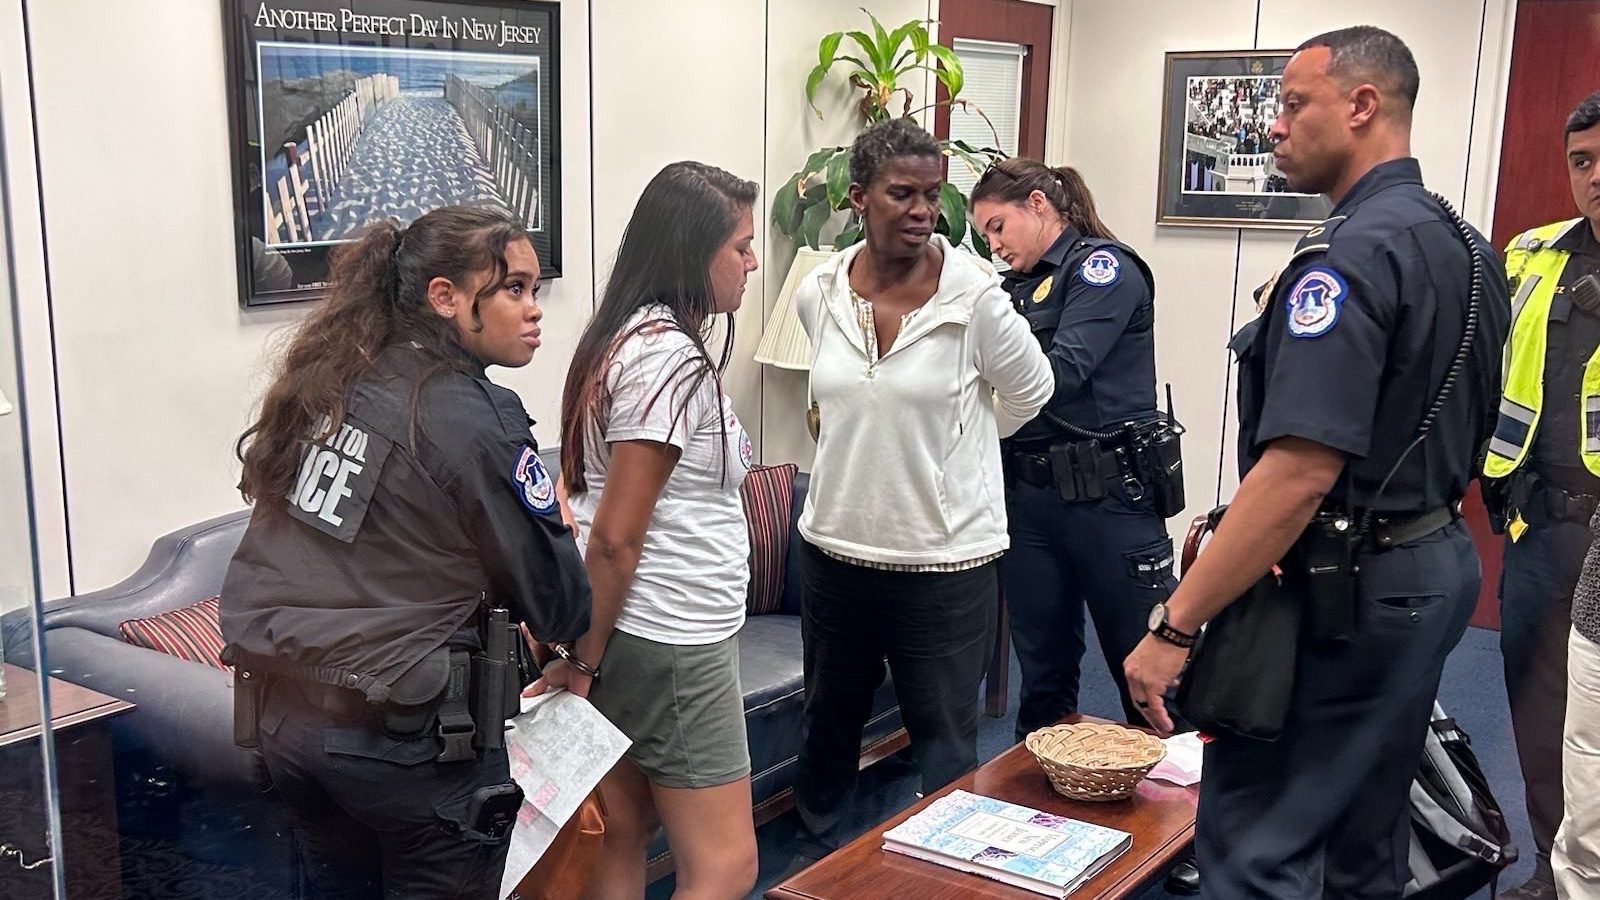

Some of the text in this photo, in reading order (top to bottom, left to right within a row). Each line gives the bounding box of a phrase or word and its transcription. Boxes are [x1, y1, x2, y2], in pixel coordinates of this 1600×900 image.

[254, 2, 338, 32] ANOTHER
[340, 8, 407, 36] PERFECT
[409, 13, 438, 38] DAY
[461, 17, 497, 41] NEW
[497, 20, 541, 47] JERSEY
